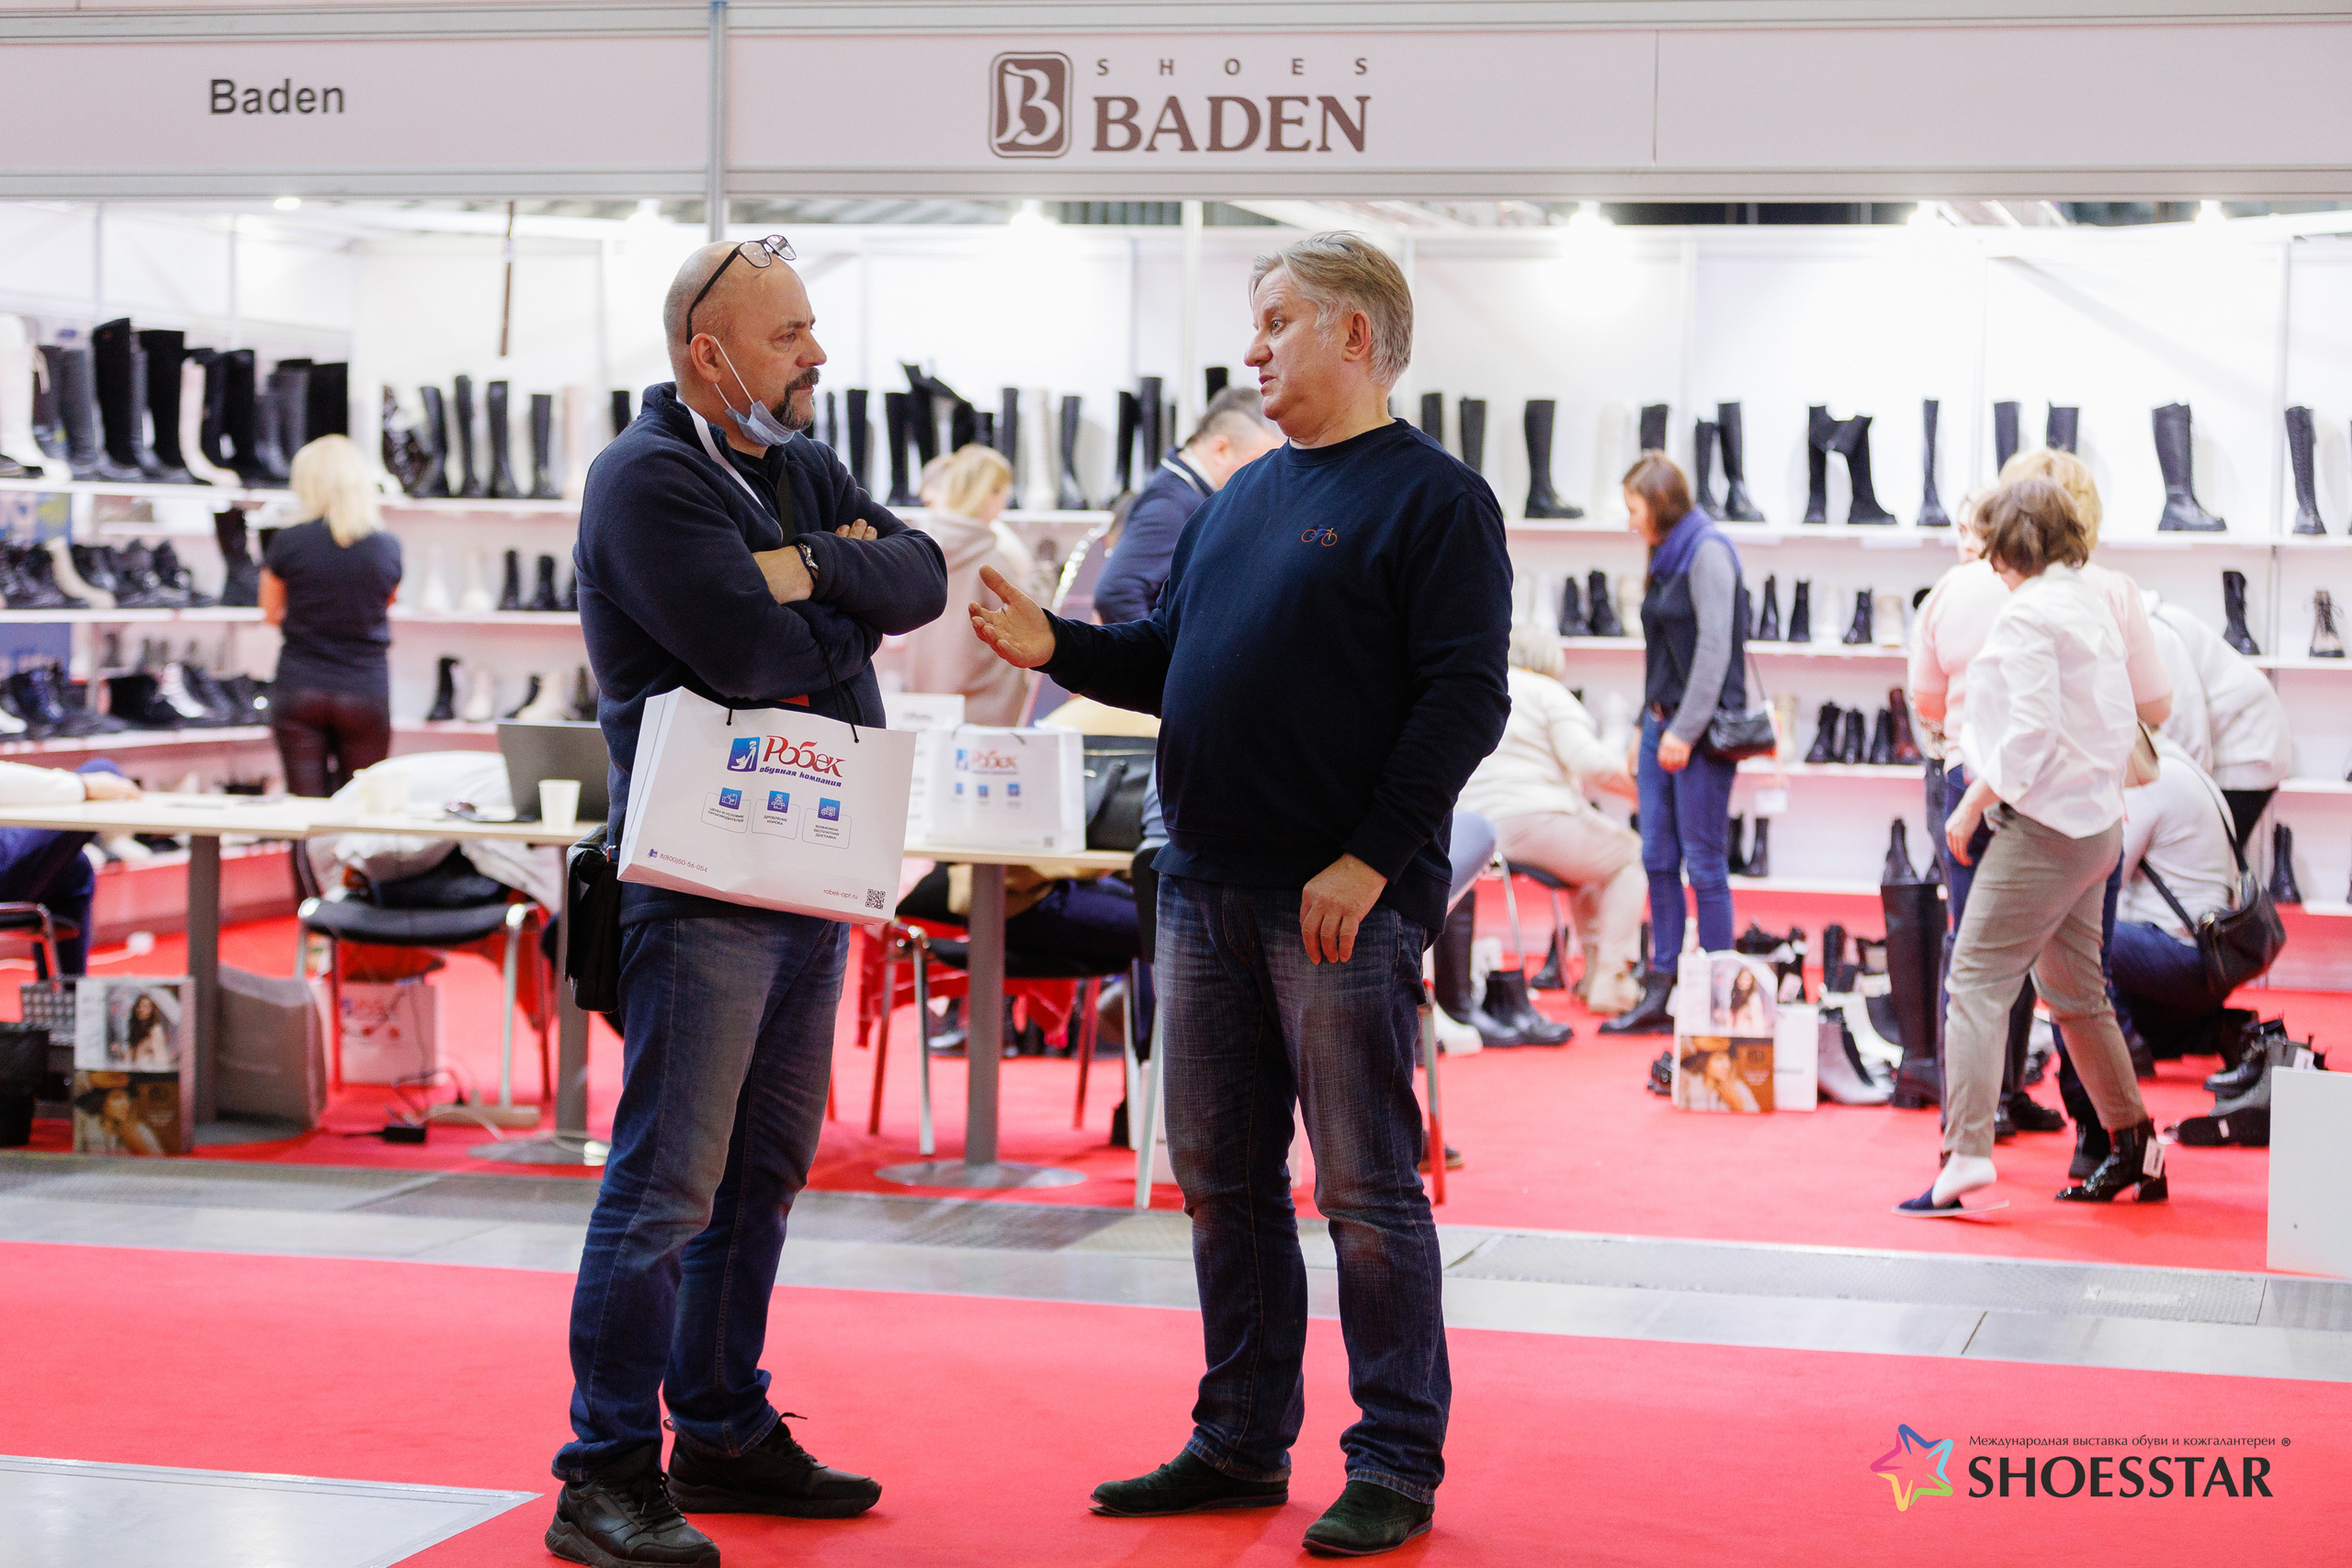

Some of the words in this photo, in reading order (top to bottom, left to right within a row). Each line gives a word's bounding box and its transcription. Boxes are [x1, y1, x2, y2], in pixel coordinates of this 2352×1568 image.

[1095, 57, 1369, 76] SHOES
[209, 78, 345, 114] Baden
[1091, 95, 1372, 153] BADEN
[763, 735, 846, 778] Робек
[759, 765, 797, 777] обувная
[798, 771, 842, 788] компания
[822, 888, 859, 900] robek-opt.ru
